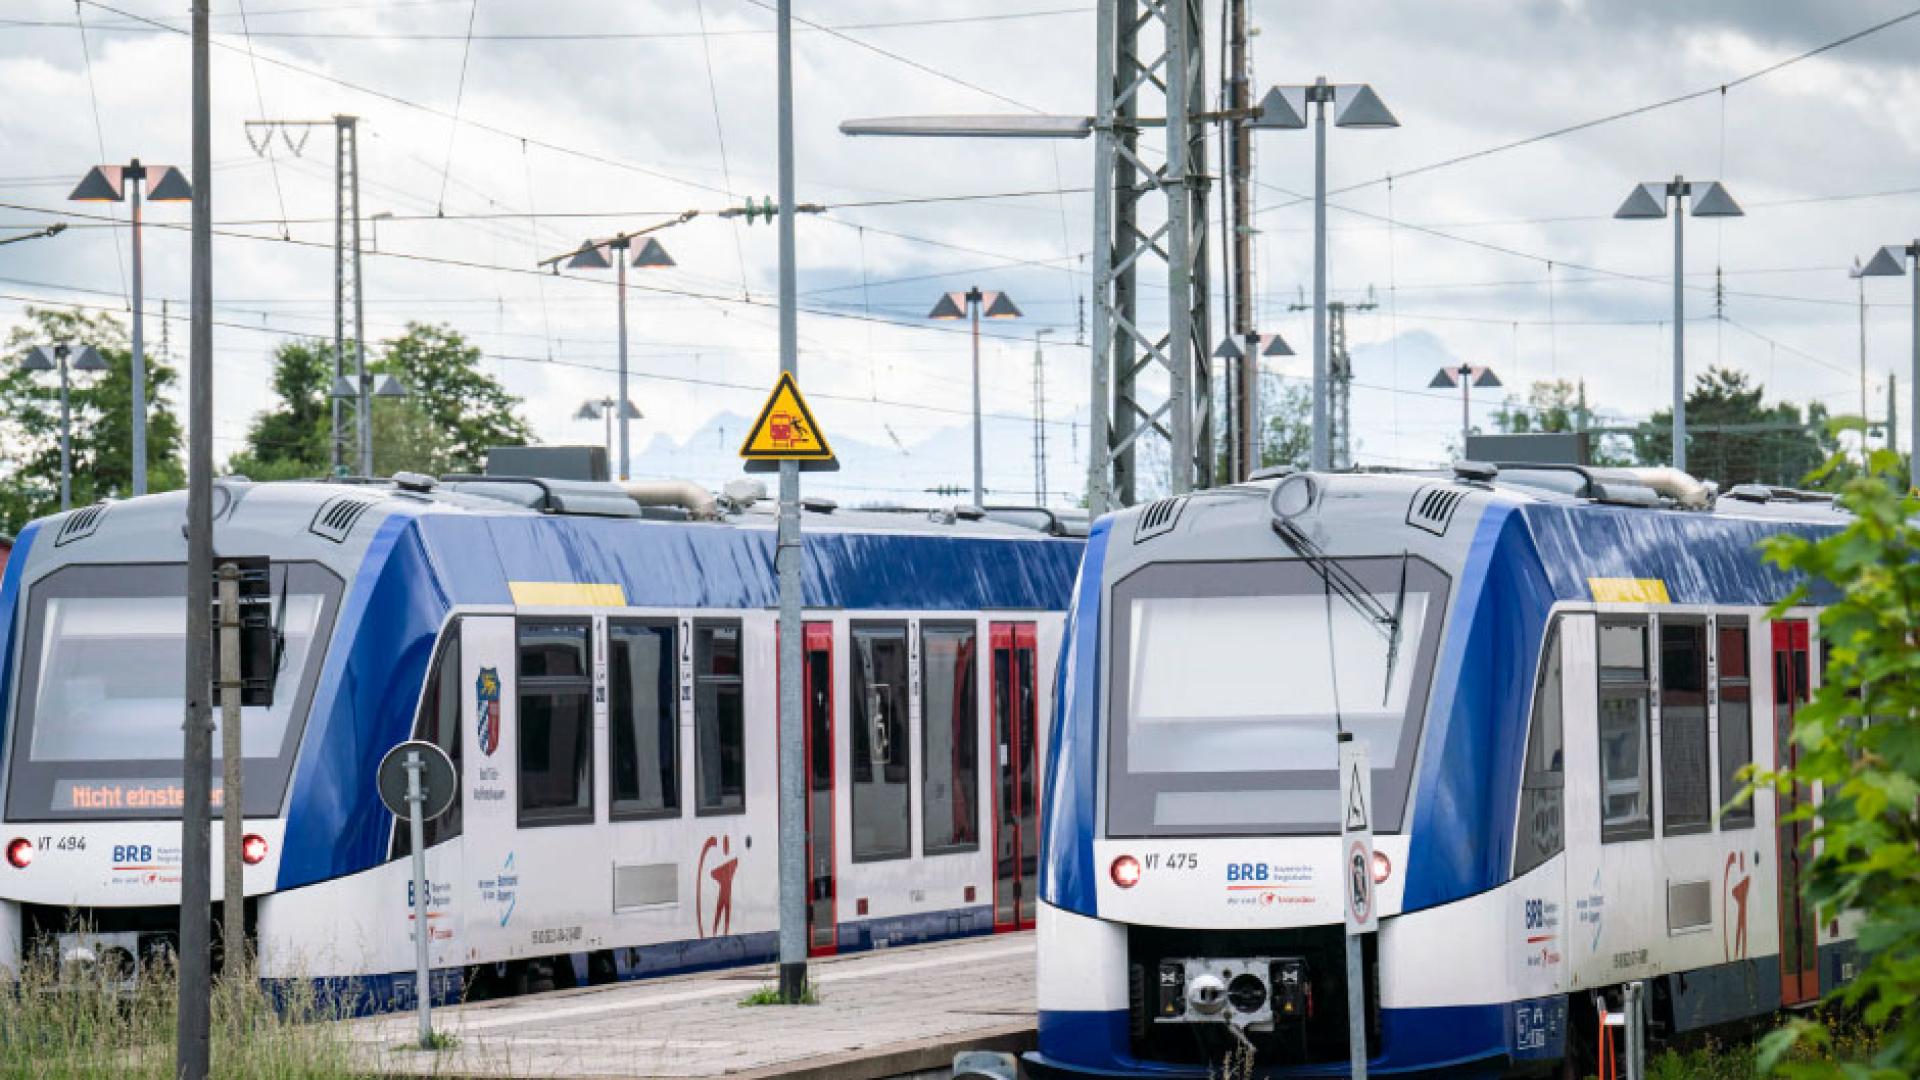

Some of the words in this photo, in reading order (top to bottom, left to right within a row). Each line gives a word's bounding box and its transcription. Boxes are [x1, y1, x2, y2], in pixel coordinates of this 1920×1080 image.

[72, 785, 121, 809] Nicht
[38, 836, 52, 851] VT
[57, 836, 86, 851] 494
[113, 845, 152, 862] BRB
[1145, 852, 1160, 869] VT
[1166, 852, 1198, 869] 475
[1226, 862, 1269, 881] BRB
[407, 879, 430, 907] BB
[1525, 898, 1543, 929] BRB
